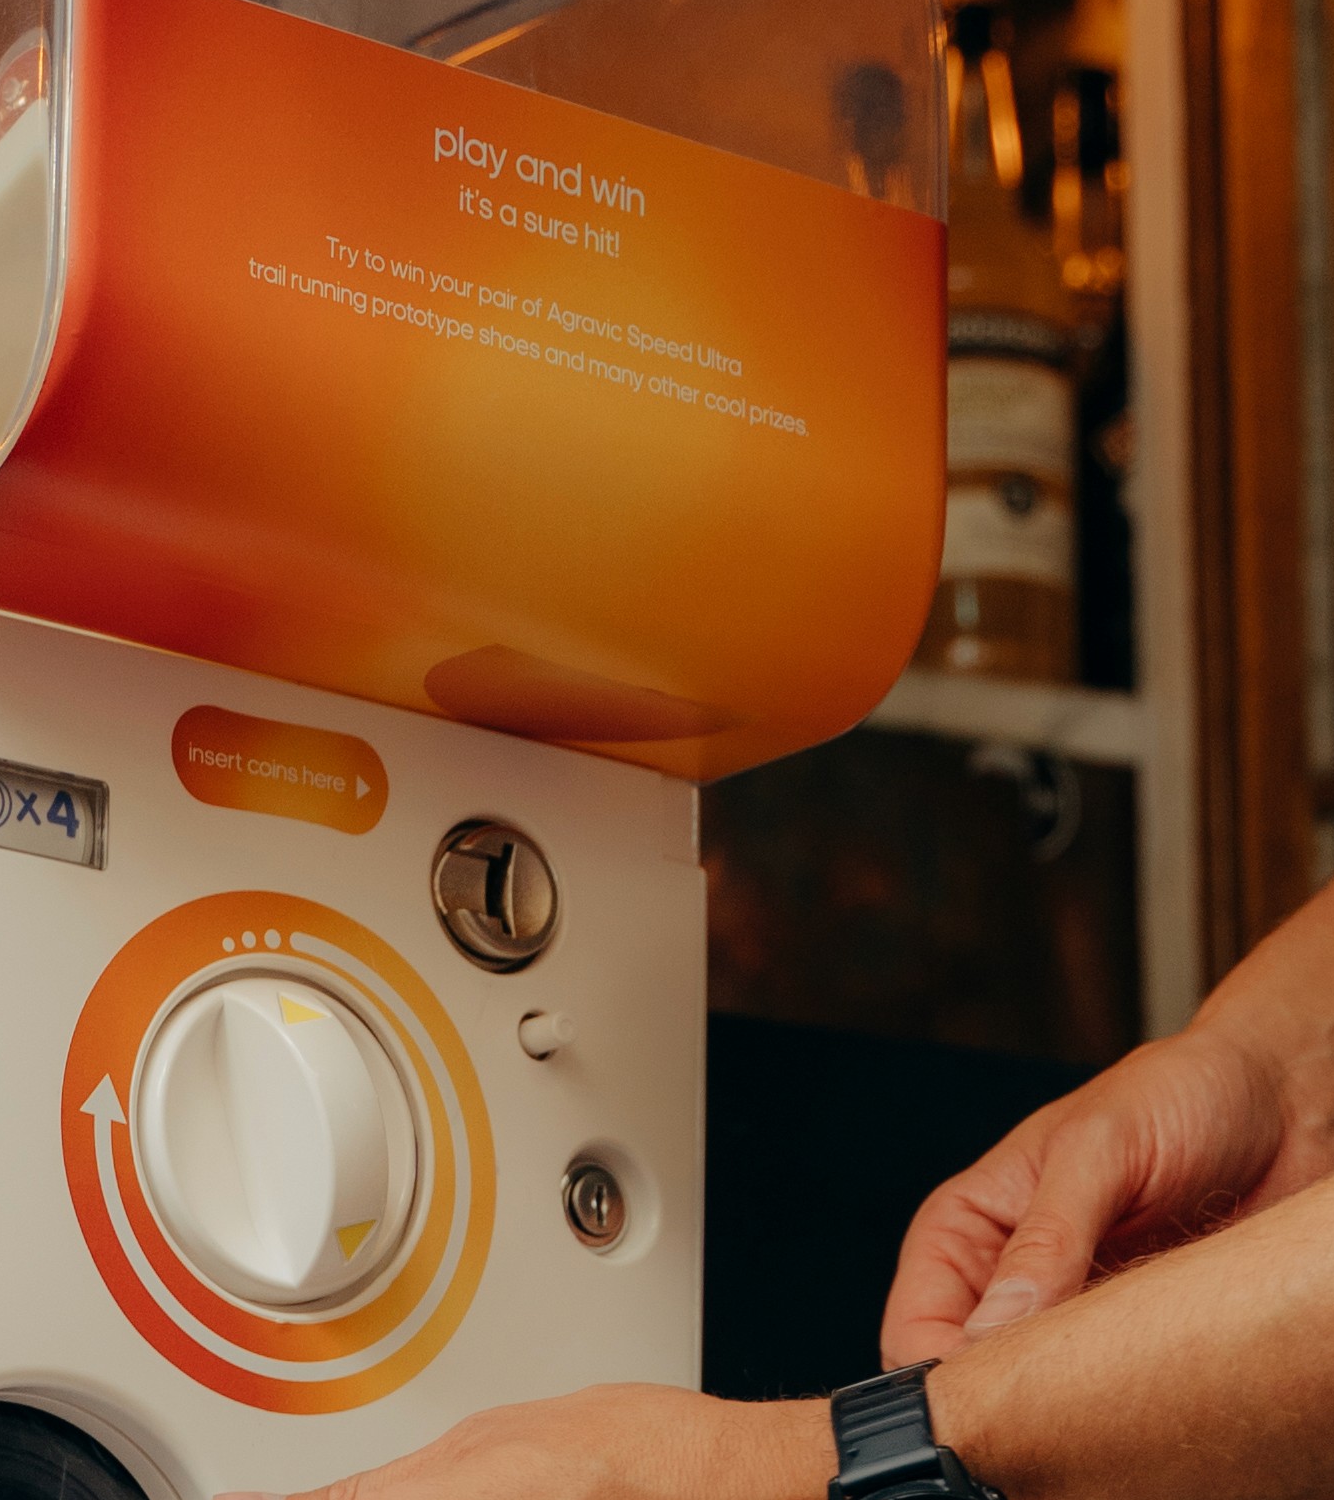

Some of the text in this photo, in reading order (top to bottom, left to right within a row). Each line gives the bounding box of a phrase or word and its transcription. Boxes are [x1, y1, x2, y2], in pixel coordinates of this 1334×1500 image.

[434, 125, 646, 217] play and win
[459, 185, 620, 258] it's a sure hit!
[249, 257, 810, 438] trail running prototype shoes and many other cool prizes.
[326, 235, 742, 377] Try to win your pair of Agravic Speed Ultra
[188, 743, 345, 793] insert coins here
